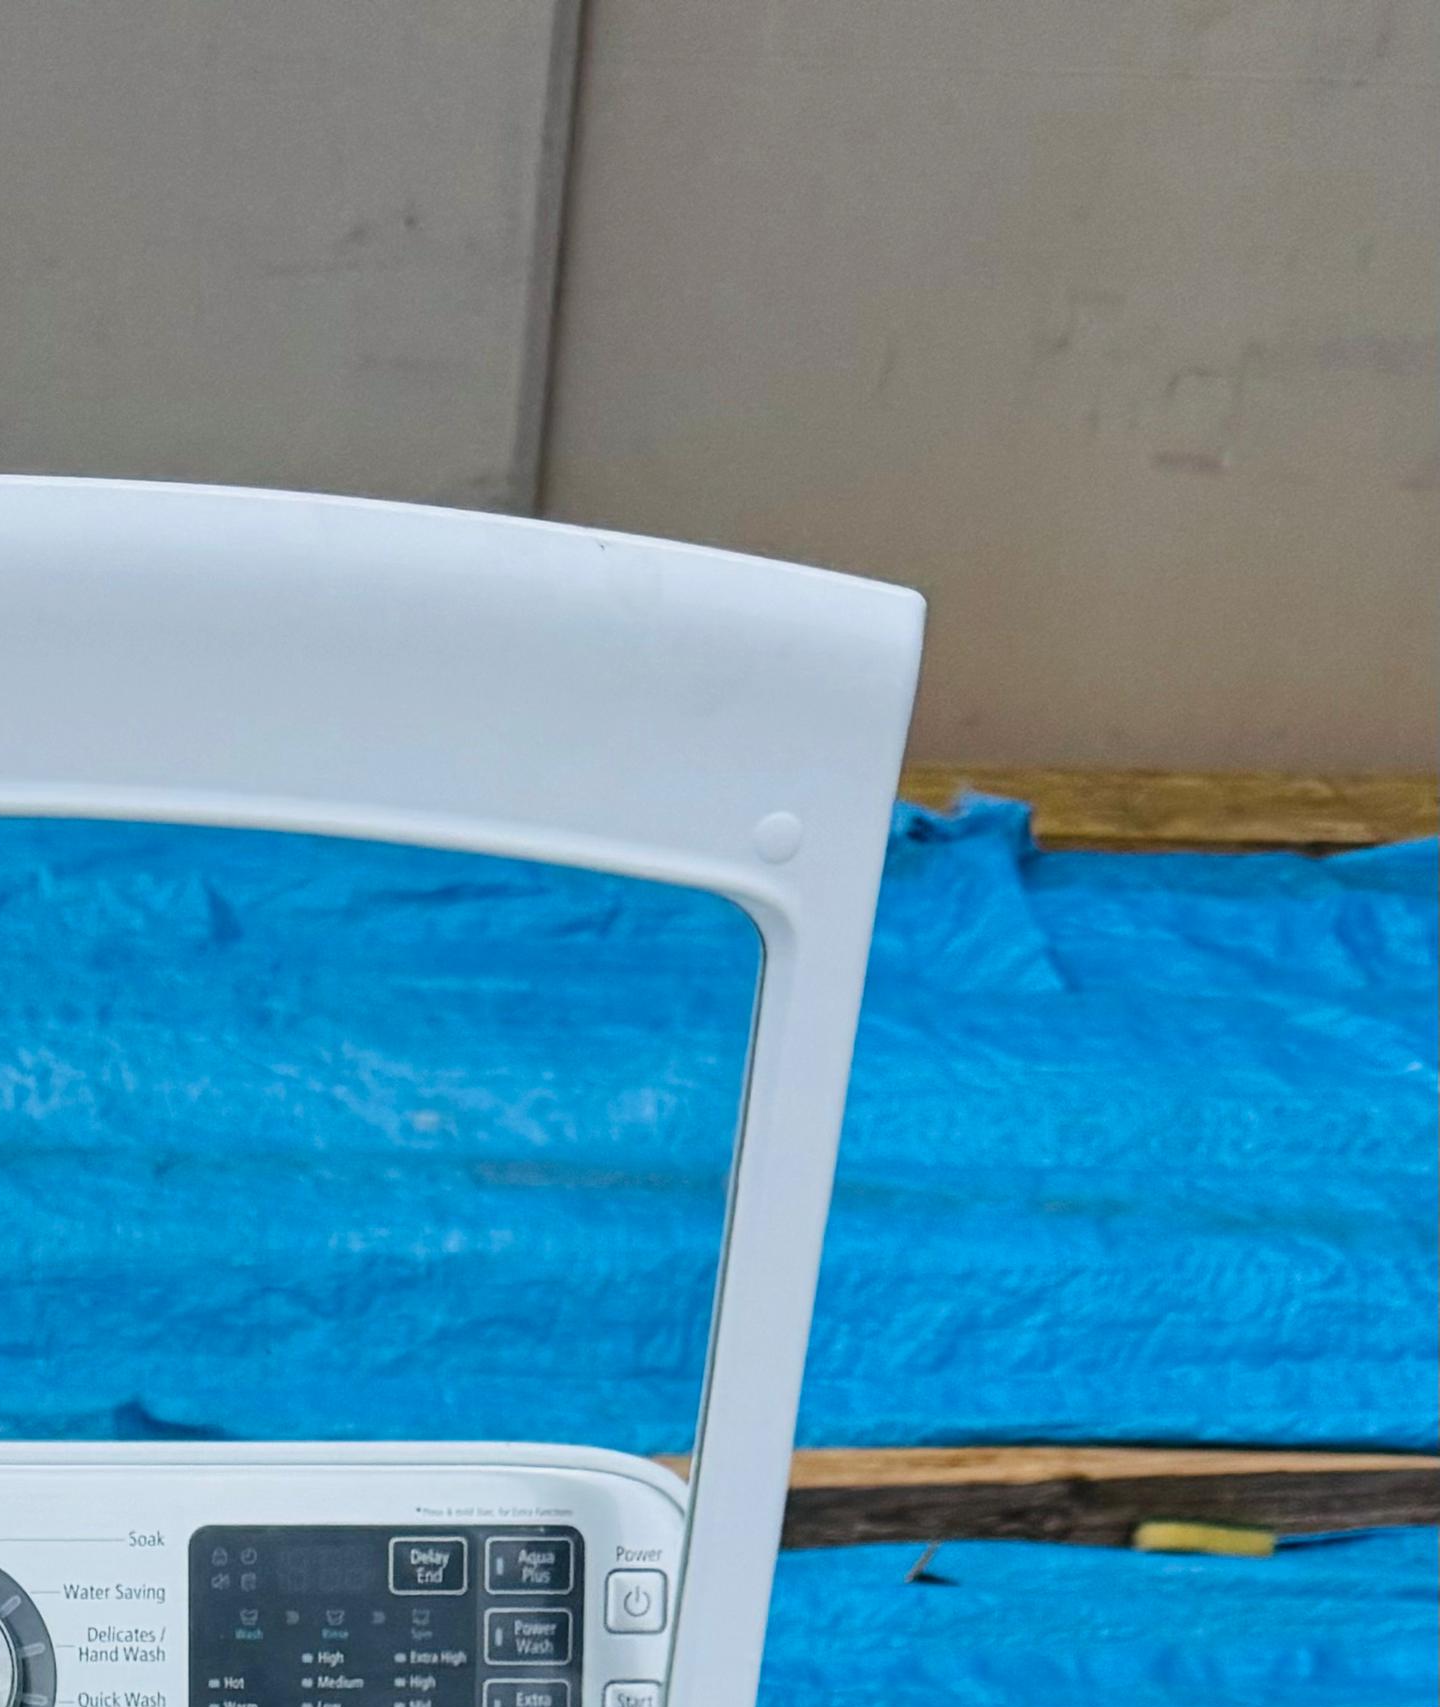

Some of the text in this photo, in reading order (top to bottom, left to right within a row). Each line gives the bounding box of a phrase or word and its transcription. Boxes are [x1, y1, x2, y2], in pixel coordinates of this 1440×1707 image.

[128, 1531, 165, 1547] Soak
[410, 1549, 450, 1569] Delay
[518, 1549, 555, 1567] Aqua
[616, 1546, 662, 1562] Power
[416, 1567, 443, 1584] End
[522, 1566, 550, 1583] Plus
[63, 1584, 165, 1605] Water Saving
[87, 1626, 154, 1643] Delicates
[514, 1619, 557, 1636] Power
[78, 1646, 166, 1663] Hand Wash
[516, 1639, 554, 1655] Wash
[317, 1650, 344, 1667] High
[410, 1651, 467, 1667] Extra High
[224, 1676, 245, 1690] Hot
[317, 1674, 364, 1689] Medium
[410, 1674, 436, 1691] High
[516, 1692, 552, 1707] Extra
